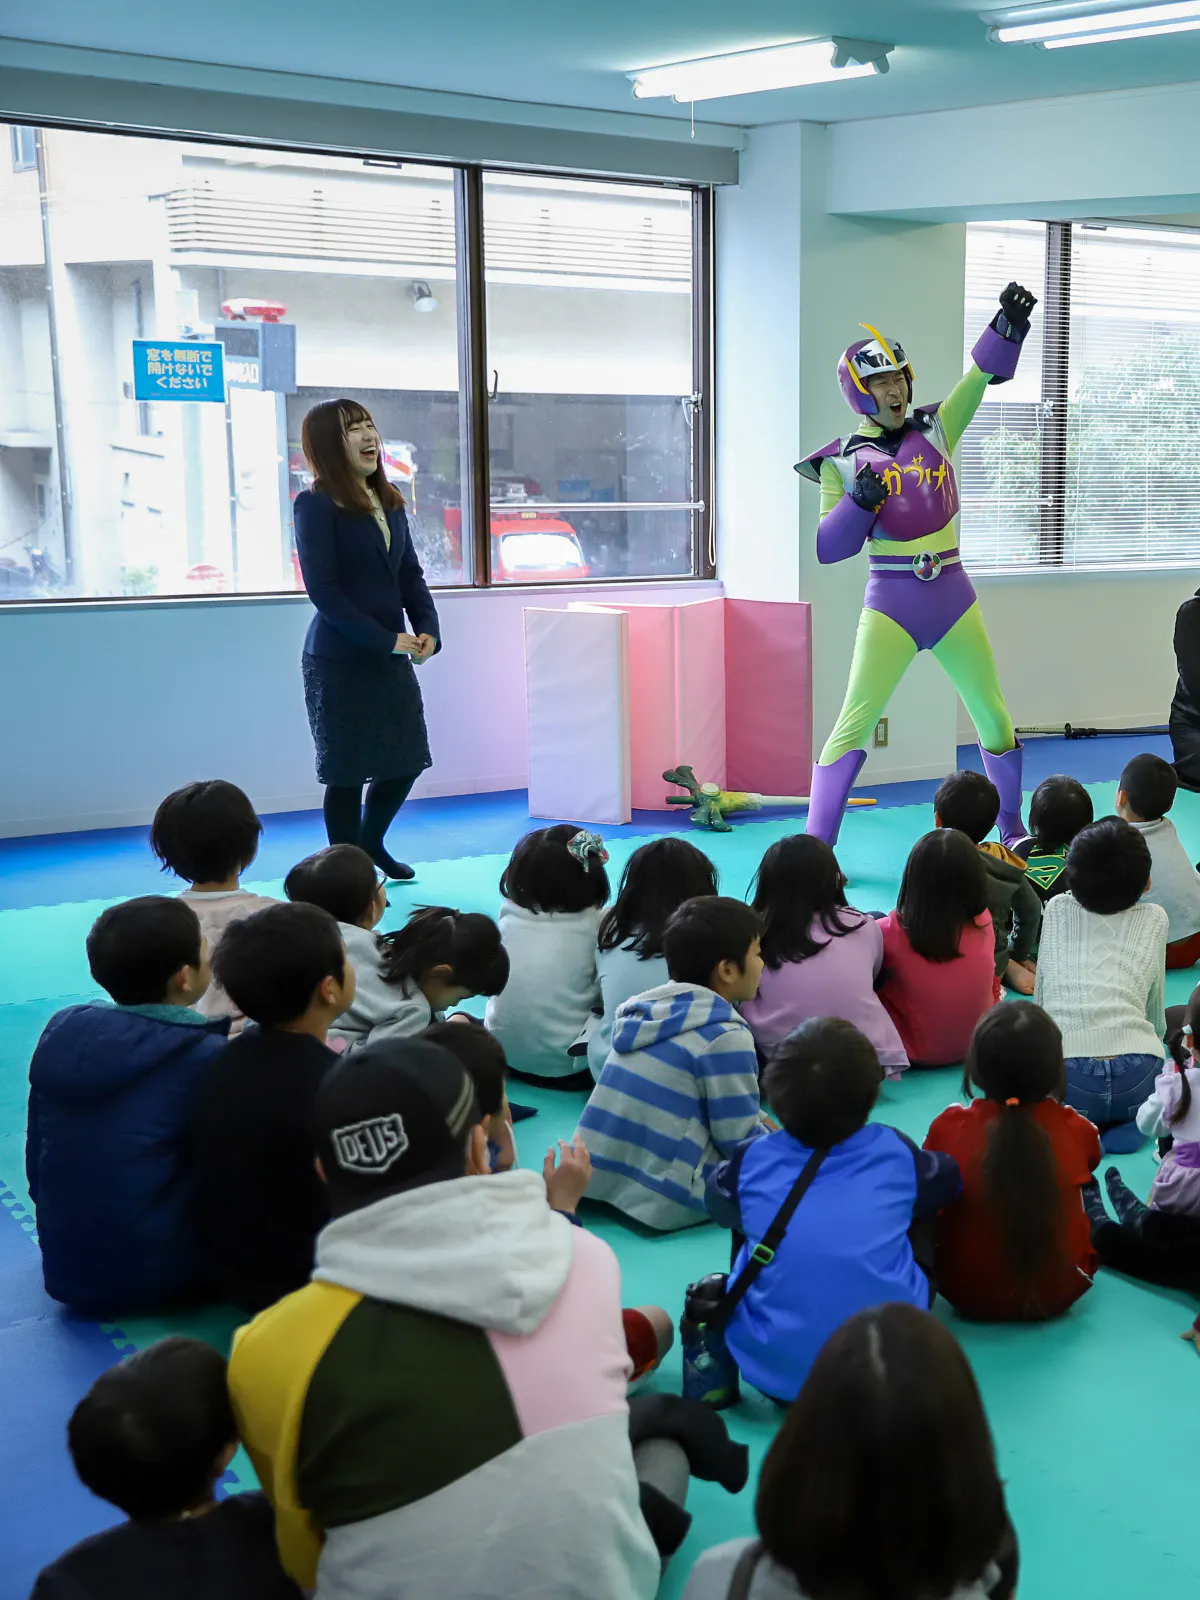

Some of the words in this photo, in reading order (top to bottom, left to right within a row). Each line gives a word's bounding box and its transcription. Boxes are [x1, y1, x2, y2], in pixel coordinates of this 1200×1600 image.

[146, 348, 212, 362] 窓を無断で
[147, 362, 213, 376] 開けないで
[156, 376, 208, 389] ください
[340, 1123, 398, 1163] DEUS
